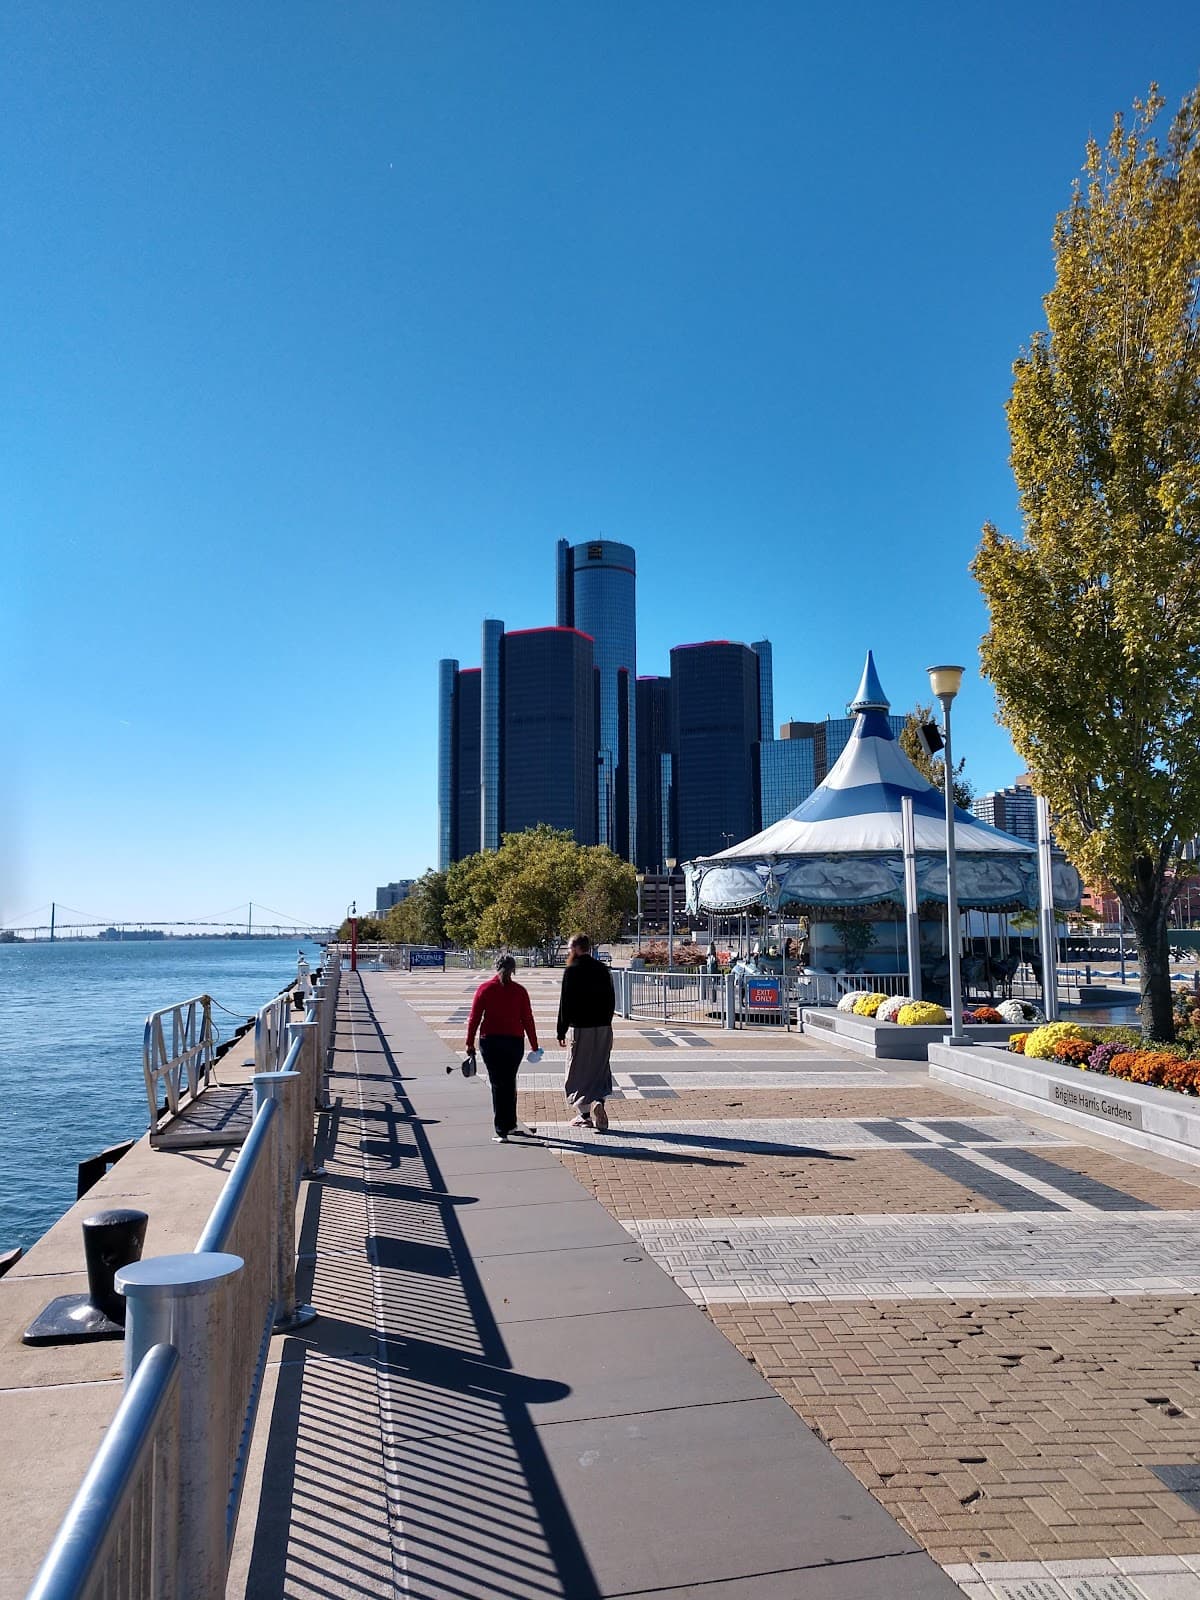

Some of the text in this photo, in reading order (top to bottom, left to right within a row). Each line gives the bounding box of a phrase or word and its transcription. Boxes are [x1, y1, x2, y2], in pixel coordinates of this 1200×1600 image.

[1055, 1086, 1132, 1121] Brigitte Harris Gardens
